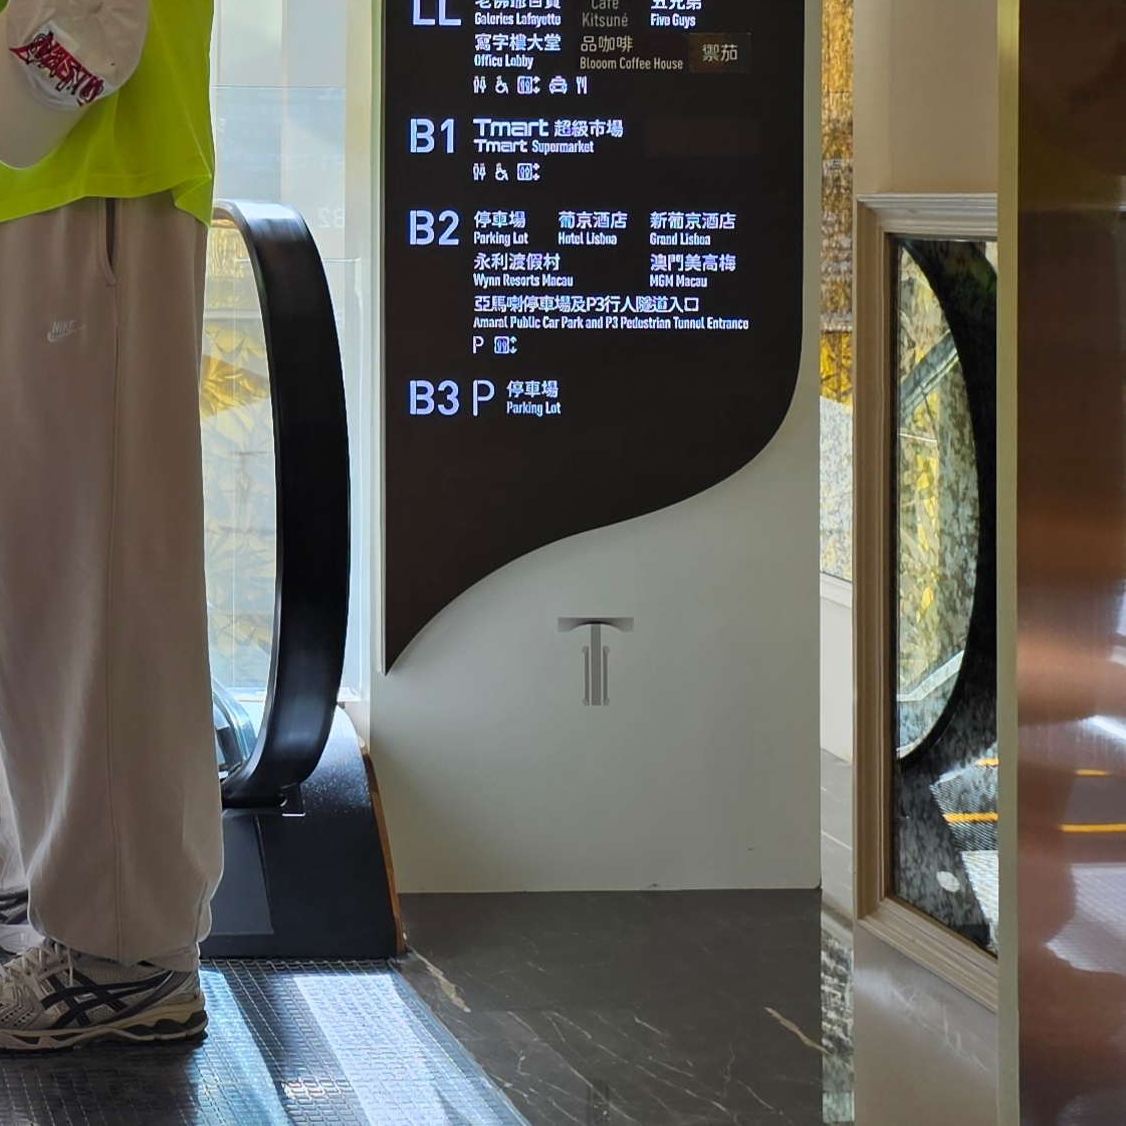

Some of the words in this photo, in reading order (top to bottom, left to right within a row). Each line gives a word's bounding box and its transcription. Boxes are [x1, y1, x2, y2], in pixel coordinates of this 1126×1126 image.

[516, 13, 561, 28] Lafayette
[582, 13, 628, 27] Kitsuné
[651, 14, 670, 26] Five
[672, 14, 696, 29] Guys
[580, 36, 633, 53] 品咖啡
[474, 54, 502, 67] Office
[505, 54, 534, 69] Lobby
[580, 57, 617, 69] Blooom
[620, 57, 651, 69] Coffee
[654, 58, 683, 70] House
[410, 118, 454, 153] B1
[473, 119, 549, 136] Tmart
[554, 120, 623, 138] 超級市場
[473, 139, 527, 152] Tmart
[532, 140, 594, 155] Supermarket
[474, 211, 526, 228] 停車場
[558, 211, 627, 229] 葡京酒店
[650, 212, 736, 229] 新葡京酒店
[409, 210, 459, 245] B2
[474, 232, 510, 247] Parking
[513, 232, 528, 244] Lot
[558, 232, 583, 245] Hotel
[586, 232, 617, 245] Lisboa
[650, 233, 677, 245] Grand
[680, 233, 710, 246] Lisboa
[474, 253, 560, 271] 永利渡假村
[650, 254, 736, 271] 澳門美高梅
[473, 274, 500, 288] Wynn
[503, 274, 540, 286] Resorts
[542, 274, 573, 286] Macau
[650, 275, 673, 287] MGM
[676, 276, 707, 287] Macau
[52, 320, 76, 334] NIKE
[473, 316, 508, 328] Amaral
[510, 316, 540, 329] Public
[542, 317, 559, 329] Car
[562, 317, 583, 329] Park
[585, 317, 603, 329] and
[606, 317, 618, 329] P3
[621, 317, 671, 329] Pedestrian
[673, 317, 705, 329] Tunnel
[707, 317, 748, 330] Entrance
[506, 380, 558, 398] 停車場
[409, 380, 459, 415] B3
[506, 402, 543, 417] Parking
[545, 402, 561, 414] Lot
